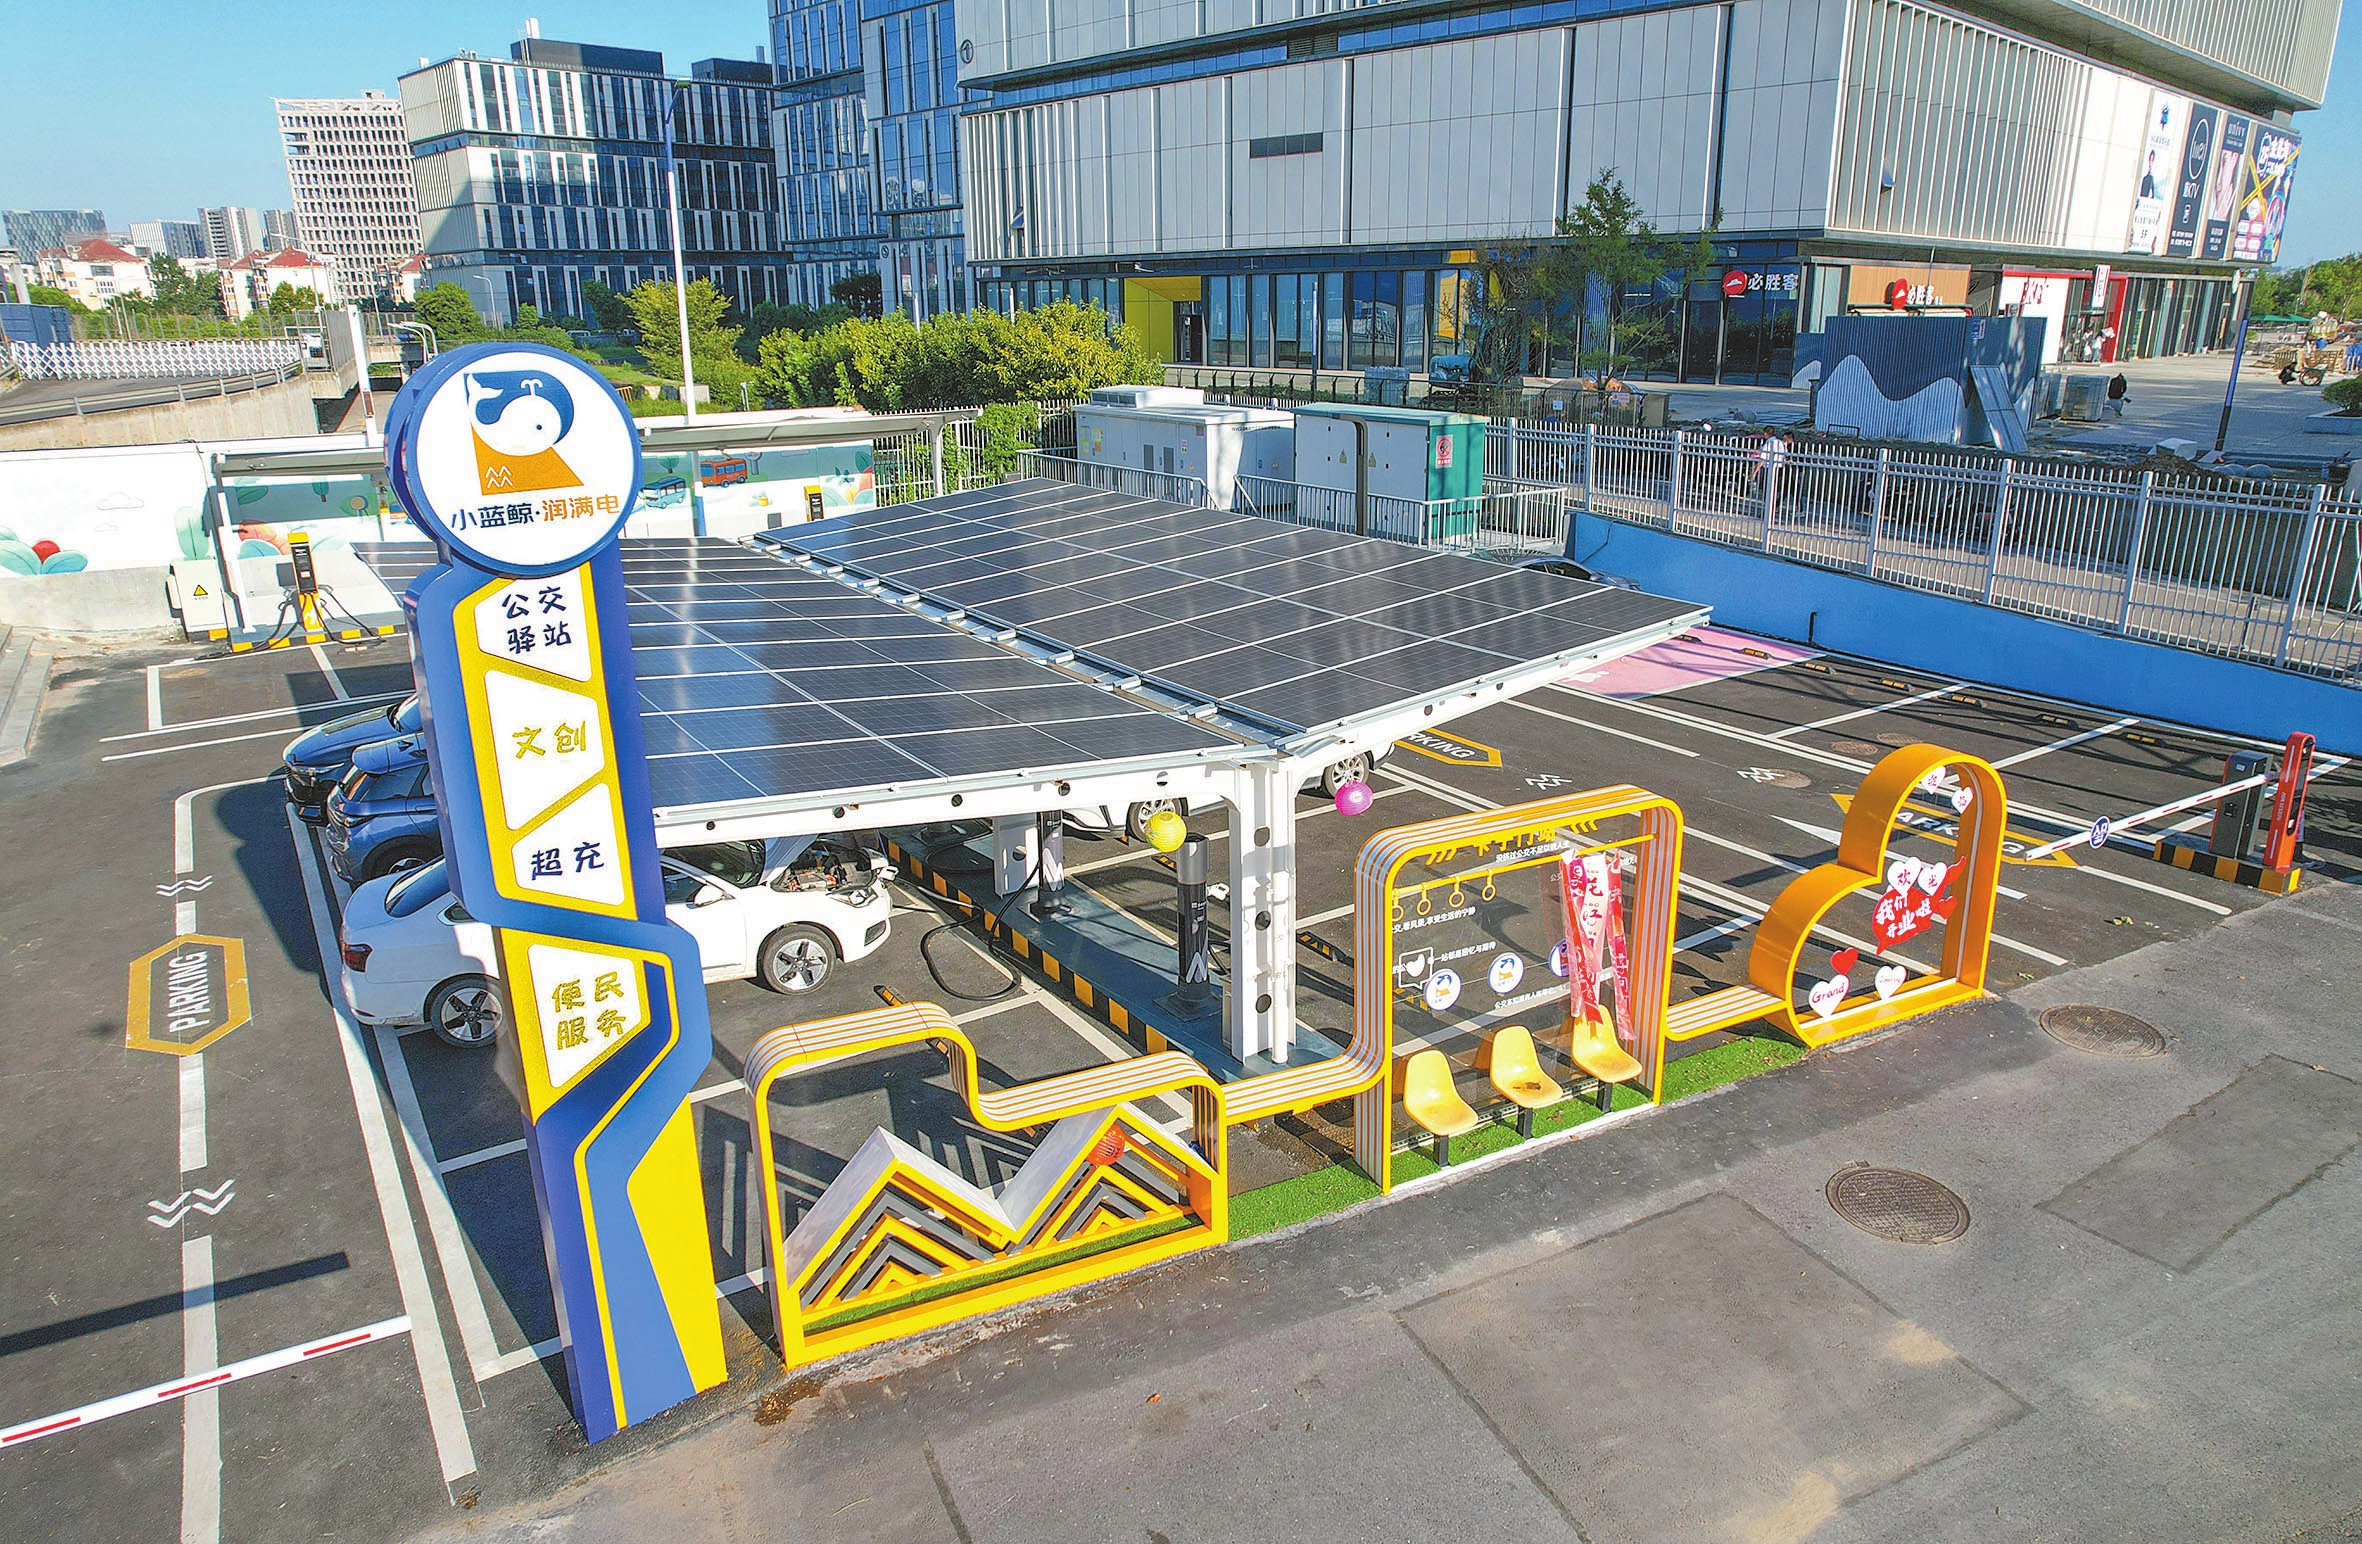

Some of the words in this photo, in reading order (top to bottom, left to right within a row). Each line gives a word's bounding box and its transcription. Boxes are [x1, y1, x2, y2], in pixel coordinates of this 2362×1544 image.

[1748, 273, 1799, 291] 必胜客
[1906, 284, 1935, 305] 必胜客
[451, 494, 620, 531] 小蓝鲸·润满电
[502, 586, 567, 619] 公交
[507, 621, 572, 654] 驿站
[512, 720, 586, 759] 文创
[530, 841, 605, 881] 超充
[1897, 869, 1911, 887] 欢
[1876, 892, 1908, 925] 我们
[167, 951, 211, 1032] PARKING
[552, 971, 625, 1013] 便民
[1811, 981, 1845, 1003] Grand
[557, 1009, 626, 1051] 服务
